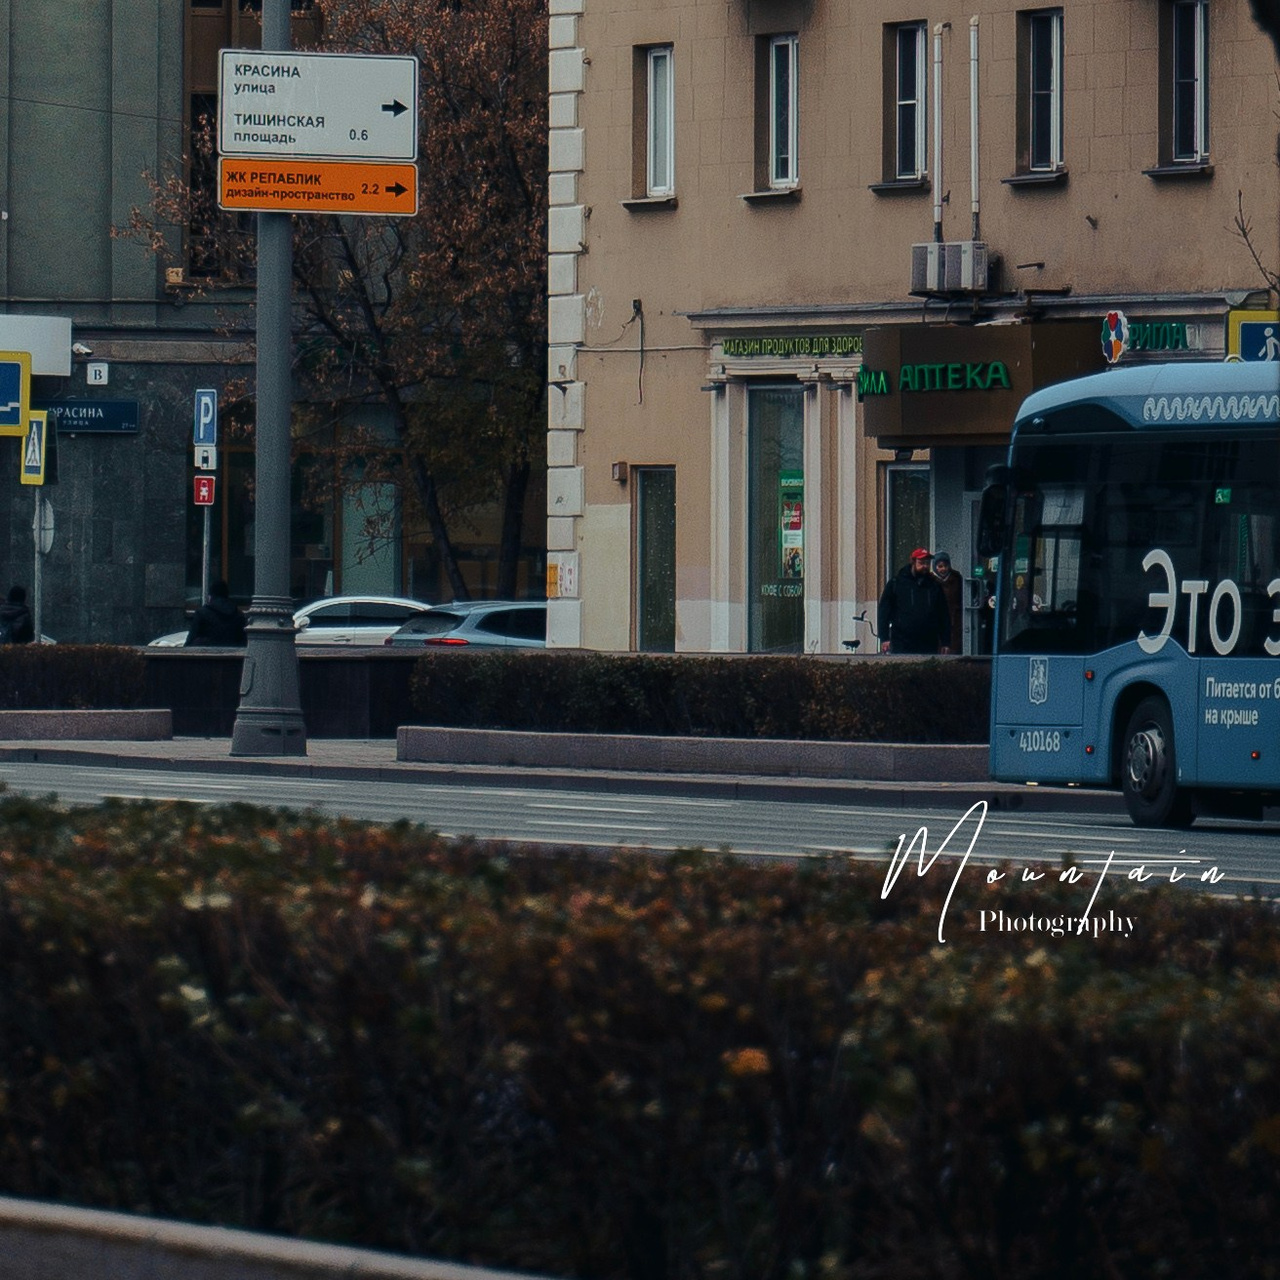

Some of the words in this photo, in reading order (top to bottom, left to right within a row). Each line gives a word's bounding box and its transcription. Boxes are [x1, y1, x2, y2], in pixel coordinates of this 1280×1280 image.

[235, 64, 301, 78] КРАСИНА
[234, 84, 275, 95] улица
[234, 114, 325, 128] ТИШИНСКАЯ
[234, 133, 296, 144] площадь
[349, 129, 368, 140] 0.6
[227, 172, 246, 183] ЖК
[250, 172, 322, 185] РЕПАБЛИК
[226, 188, 355, 201] дизайн-пространство
[361, 183, 379, 194] 2.2
[723, 339, 759, 354] МАГАЗИН
[762, 338, 810, 354] ПРОДУКТОВ
[813, 338, 829, 352] ДЛЯ
[899, 361, 1011, 391] АПТЕКА
[1137, 548, 1242, 656] Это
[1205, 677, 1256, 699] Питается
[1259, 683, 1272, 698] от
[1205, 709, 1218, 725] на
[1220, 709, 1258, 729] крыше
[1020, 731, 1060, 752] 410168
